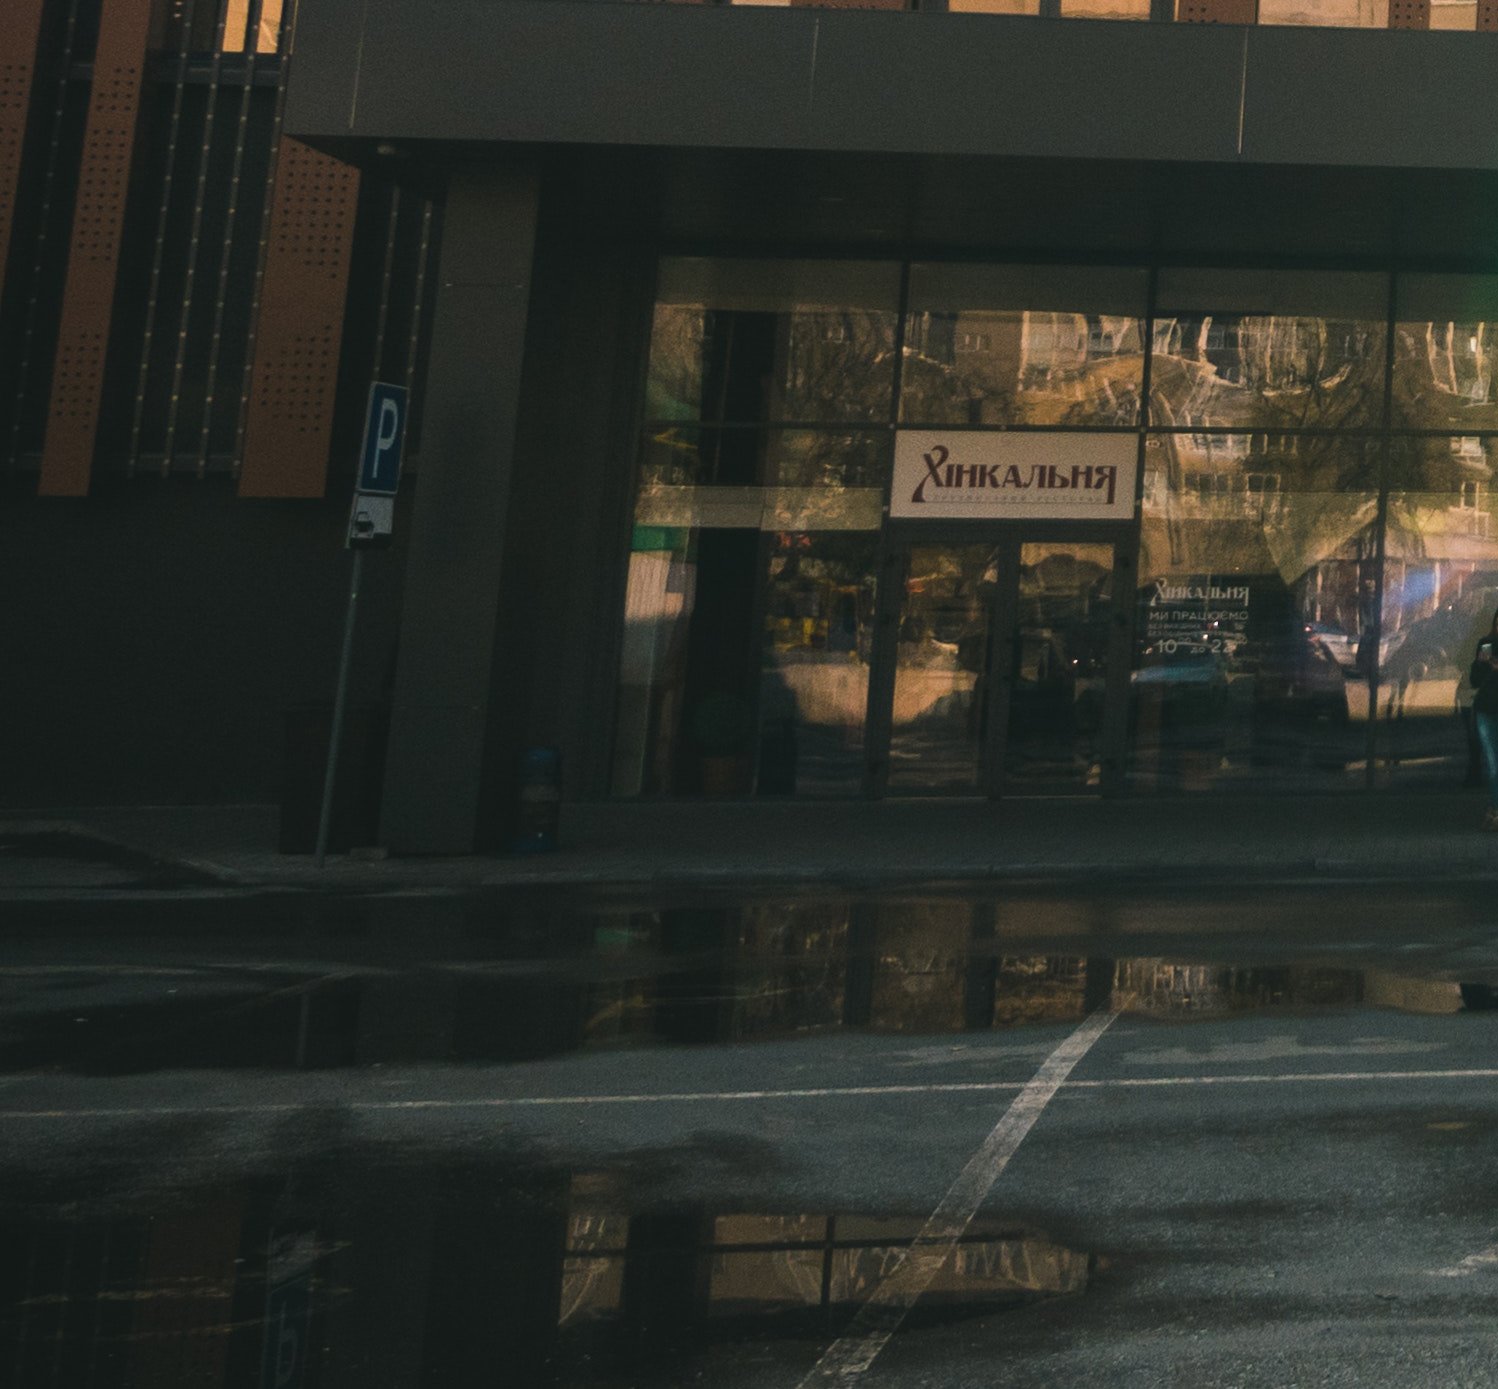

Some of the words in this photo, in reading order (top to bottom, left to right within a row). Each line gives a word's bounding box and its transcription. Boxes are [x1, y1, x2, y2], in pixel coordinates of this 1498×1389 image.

[373, 398, 398, 478] P
[911, 445, 1117, 504] ХІНКАЛЬНЯ
[1149, 611, 1169, 620] МИ
[1172, 611, 1249, 621] ПРАЦЮЄМО
